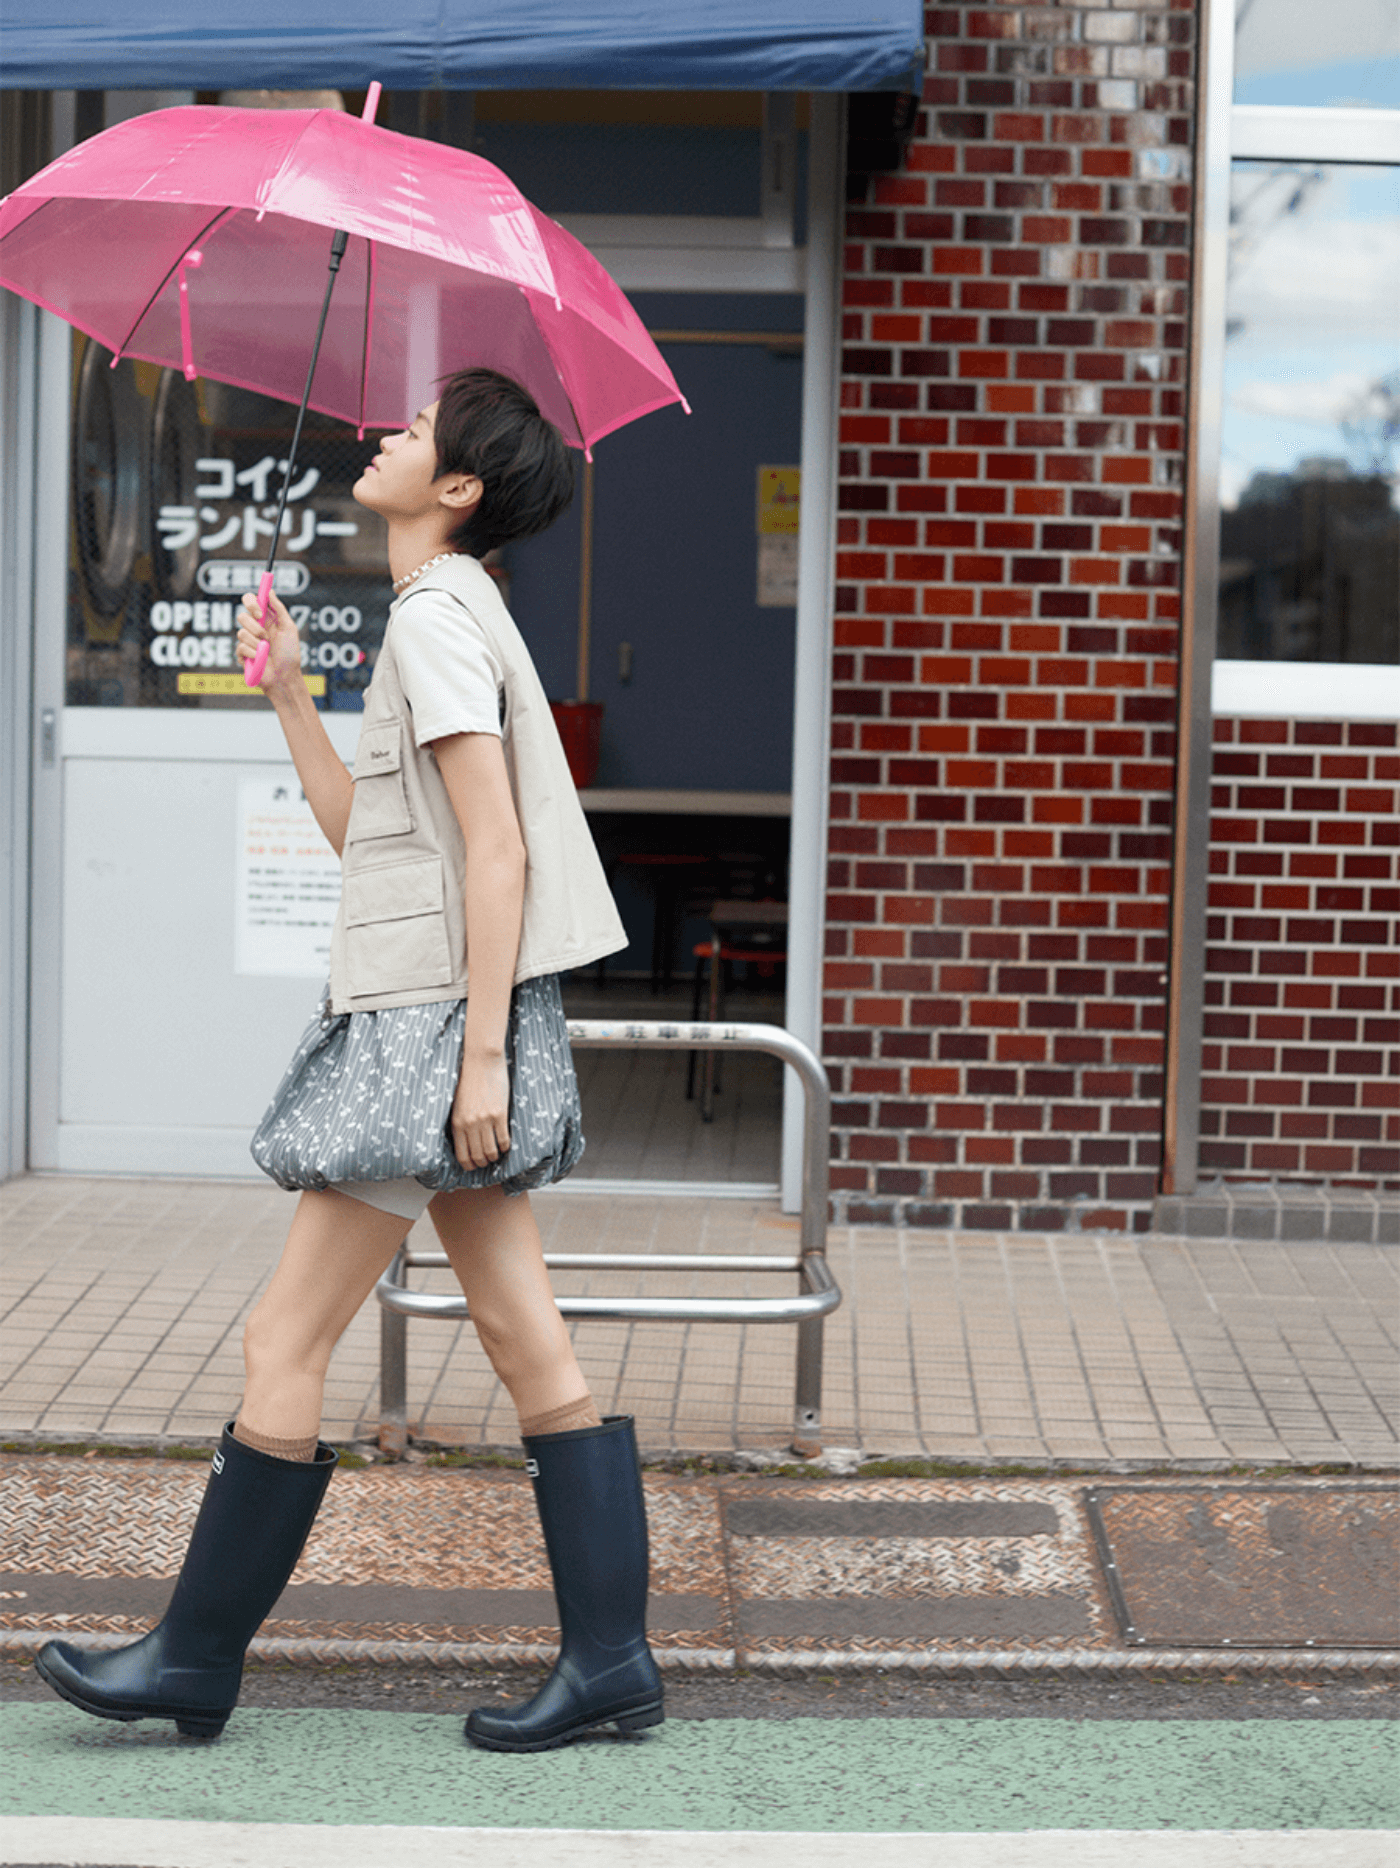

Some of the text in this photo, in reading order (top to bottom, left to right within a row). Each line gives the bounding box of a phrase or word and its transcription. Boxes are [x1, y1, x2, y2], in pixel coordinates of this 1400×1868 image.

[195, 456, 320, 501] コイン
[156, 505, 358, 552] ランドリー
[150, 601, 233, 632] OPEN
[149, 635, 233, 667] CLOSE
